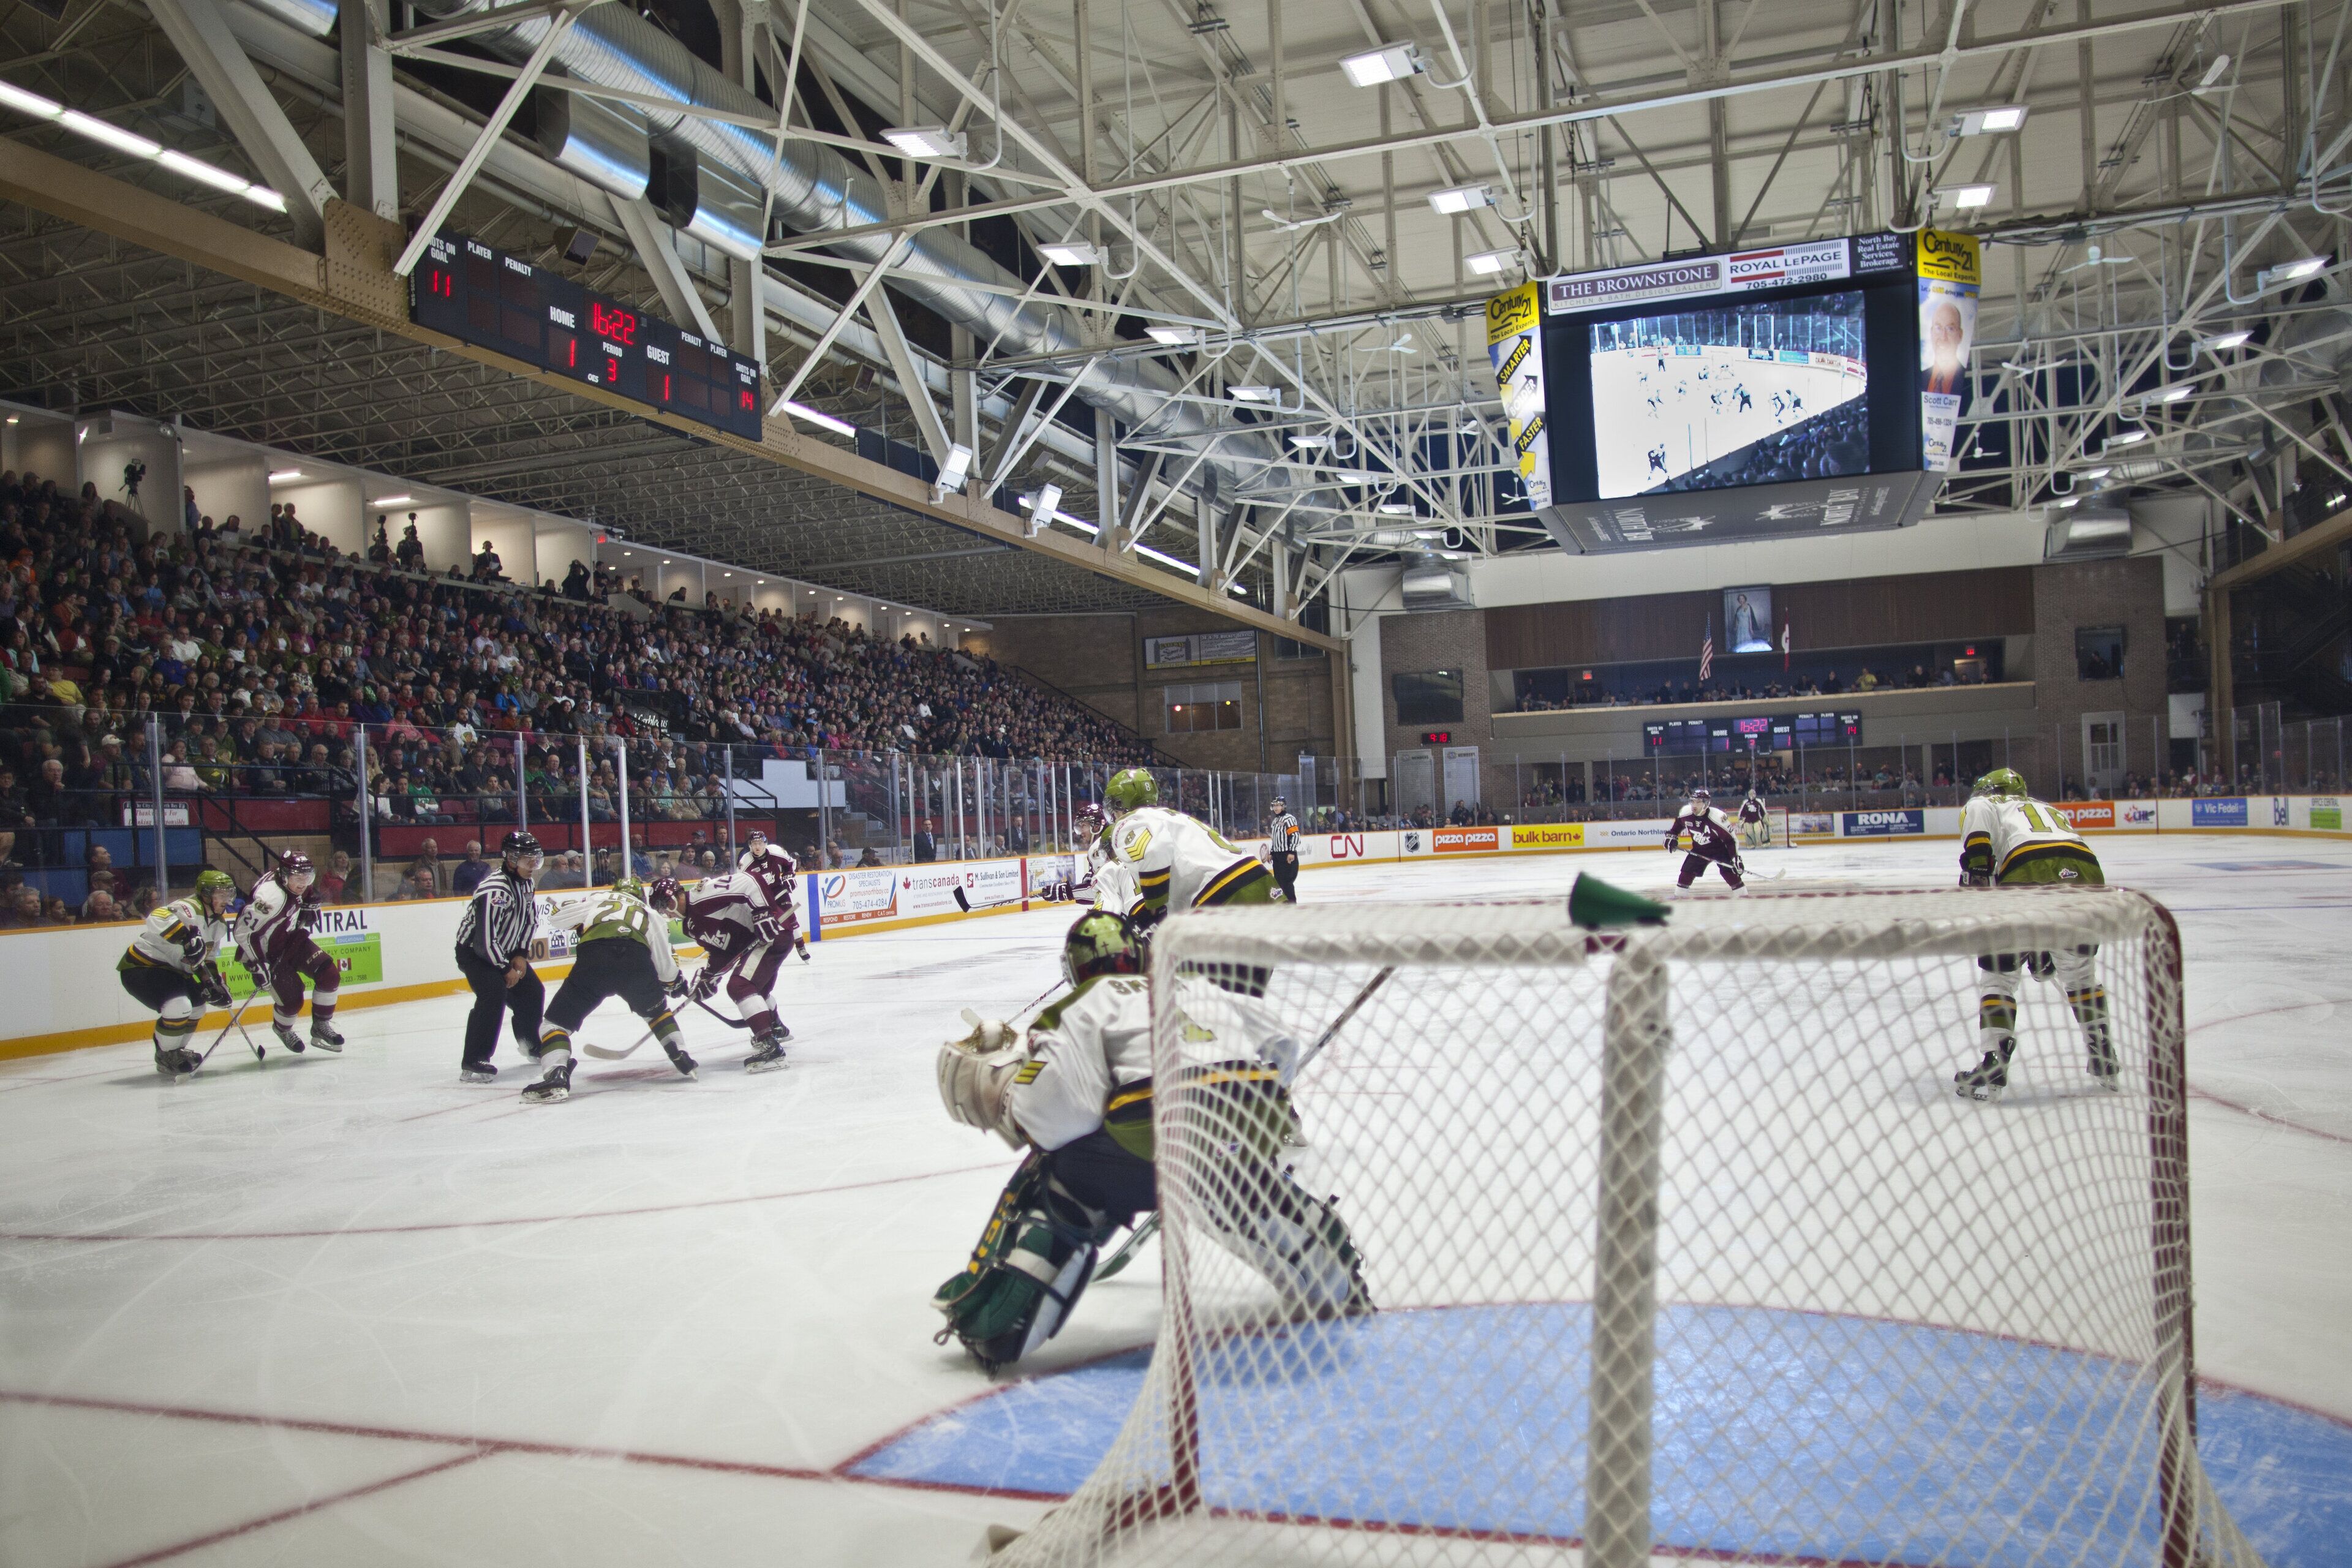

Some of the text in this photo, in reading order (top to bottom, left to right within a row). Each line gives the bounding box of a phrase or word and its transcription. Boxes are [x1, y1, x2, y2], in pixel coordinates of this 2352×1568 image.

[1876, 242, 1899, 251] Estate
[1882, 235, 1898, 244] Bay
[431, 248, 448, 263] GOAL
[446, 243, 456, 255] ON
[467, 241, 492, 260] PLAYER
[1861, 250, 1896, 260] Services,
[1924, 231, 1972, 271] Century 21
[505, 257, 532, 277] PENALTY
[1730, 260, 1781, 274] ROYAL
[1860, 258, 1899, 269] Brokerage
[434, 270, 451, 297] 11
[1559, 266, 1712, 298] THE BROWNSTONE
[1746, 273, 1828, 290] 705-472-2980
[1954, 272, 1977, 282] Experts
[1555, 297, 1594, 308] KITCHEN
[1608, 292, 1631, 301] BATH
[1635, 288, 1670, 298] DESIGN
[1675, 281, 1717, 293] GALLERY
[1491, 293, 1532, 320] Century 21
[550, 306, 575, 328] HOME
[594, 303, 635, 345] 16:22
[681, 331, 701, 347] PENALTY
[570, 339, 576, 368] 1
[603, 341, 623, 357] PERIOD
[647, 345, 670, 365] GUEST
[710, 344, 727, 358] PLAYER
[1500, 339, 1531, 383] SMARTER
[608, 358, 617, 382] 3
[736, 363, 756, 378] SHOTS ON
[665, 374, 670, 401] 1
[741, 374, 752, 385] GOAL
[742, 391, 754, 411] 14
[1509, 379, 1536, 417] BOLDER
[1924, 395, 1958, 406] Scott Carr
[1518, 417, 1544, 450] FASTER
[1819, 488, 1860, 527] NORTH BAY
[1613, 507, 1649, 531] NORTH
[1740, 718, 1768, 733] 16:22
[1144, 783, 1150, 791] 8
[2205, 803, 2239, 813] Vic Fedeli
[2312, 797, 2339, 807] OFFICE CENTRAL
[1858, 812, 1909, 825] RONA
[2077, 808, 2111, 823] pizza
[2274, 797, 2289, 826] Bell
[1512, 831, 1572, 843] bulk barn
[1704, 825, 1711, 834] A
[1331, 834, 1363, 859] CN
[1435, 832, 1496, 847] pizza pizza
[849, 872, 867, 880] DISASTER
[913, 873, 960, 890] transcanada
[974, 873, 980, 881] M.
[981, 871, 994, 881] Sullivan
[1006, 869, 1019, 878] Limited
[850, 888, 889, 899] promusnorthbay.ca
[827, 900, 846, 908] PROMUS
[853, 899, 888, 910] 705-474-4284
[243, 911, 259, 931] 21
[310, 910, 368, 933] NTRAL
[594, 900, 649, 935] 20
[341, 946, 371, 955] COMPANY
